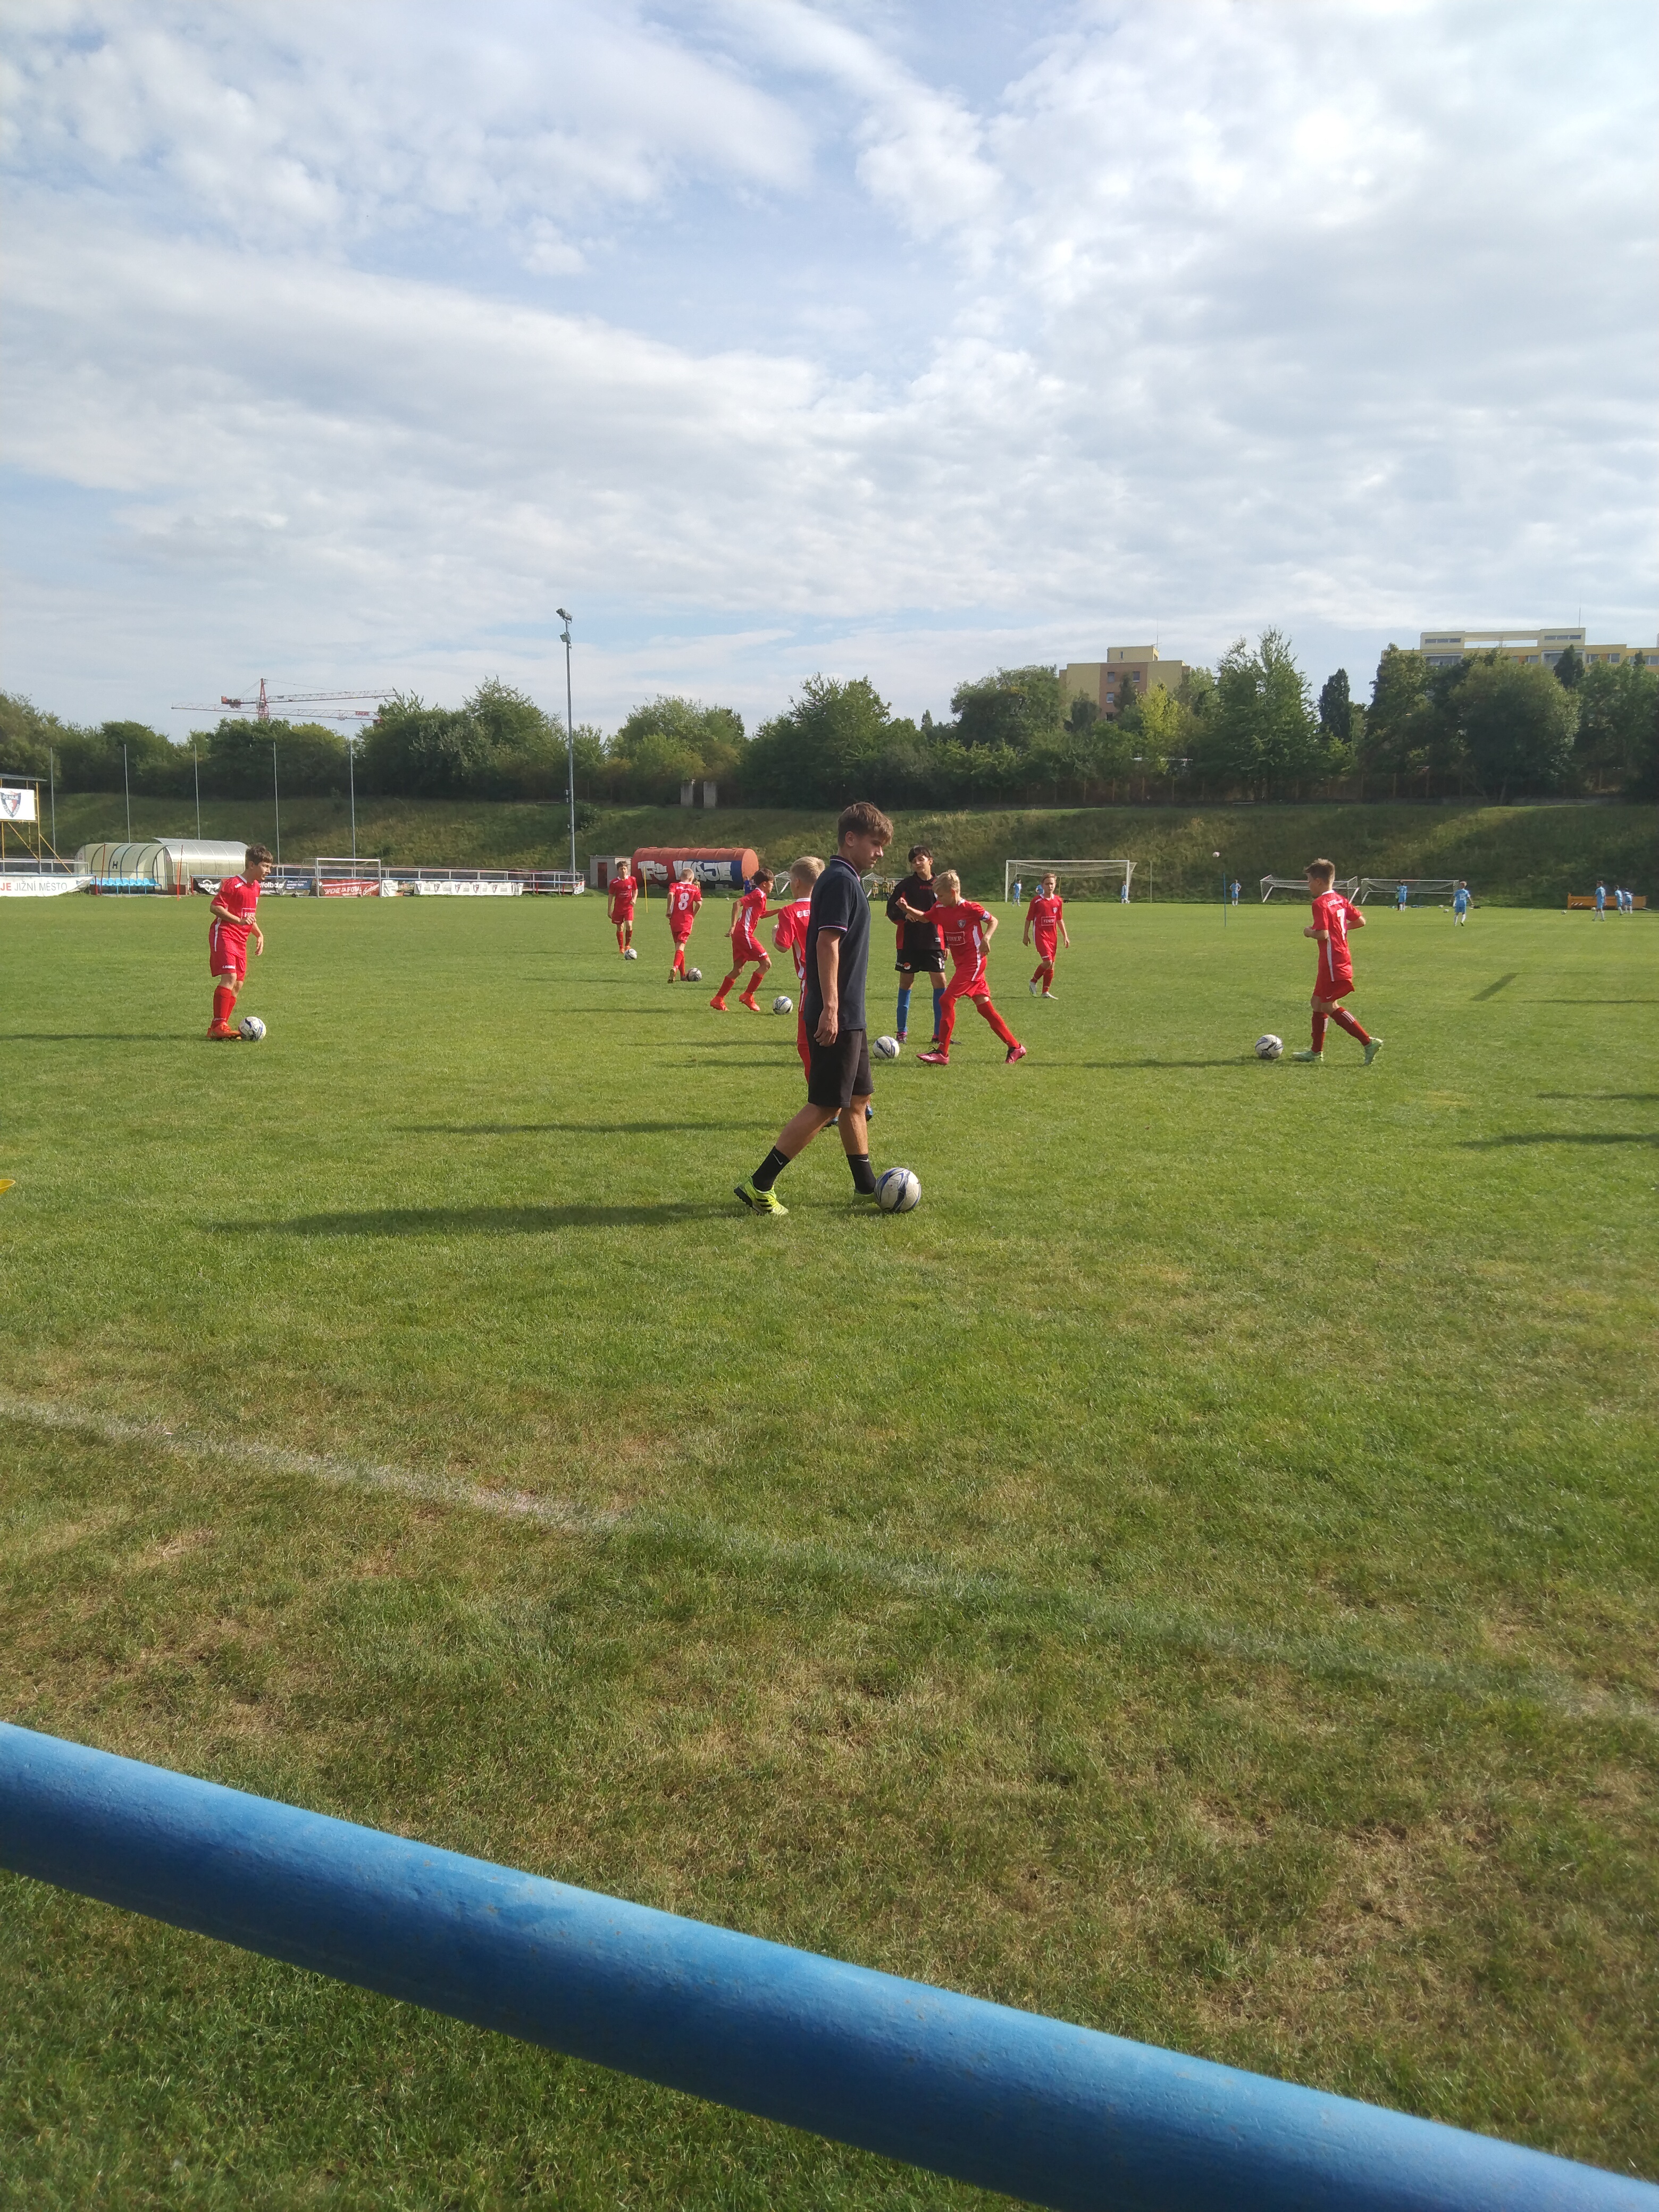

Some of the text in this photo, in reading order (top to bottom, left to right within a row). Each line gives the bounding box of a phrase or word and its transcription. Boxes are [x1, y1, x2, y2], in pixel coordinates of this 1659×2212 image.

[112, 861, 118, 869] H
[638, 860, 668, 881] FC
[0, 882, 12, 891] JE
[14, 881, 36, 891] JIŽNÍ
[678, 892, 690, 911] 8
